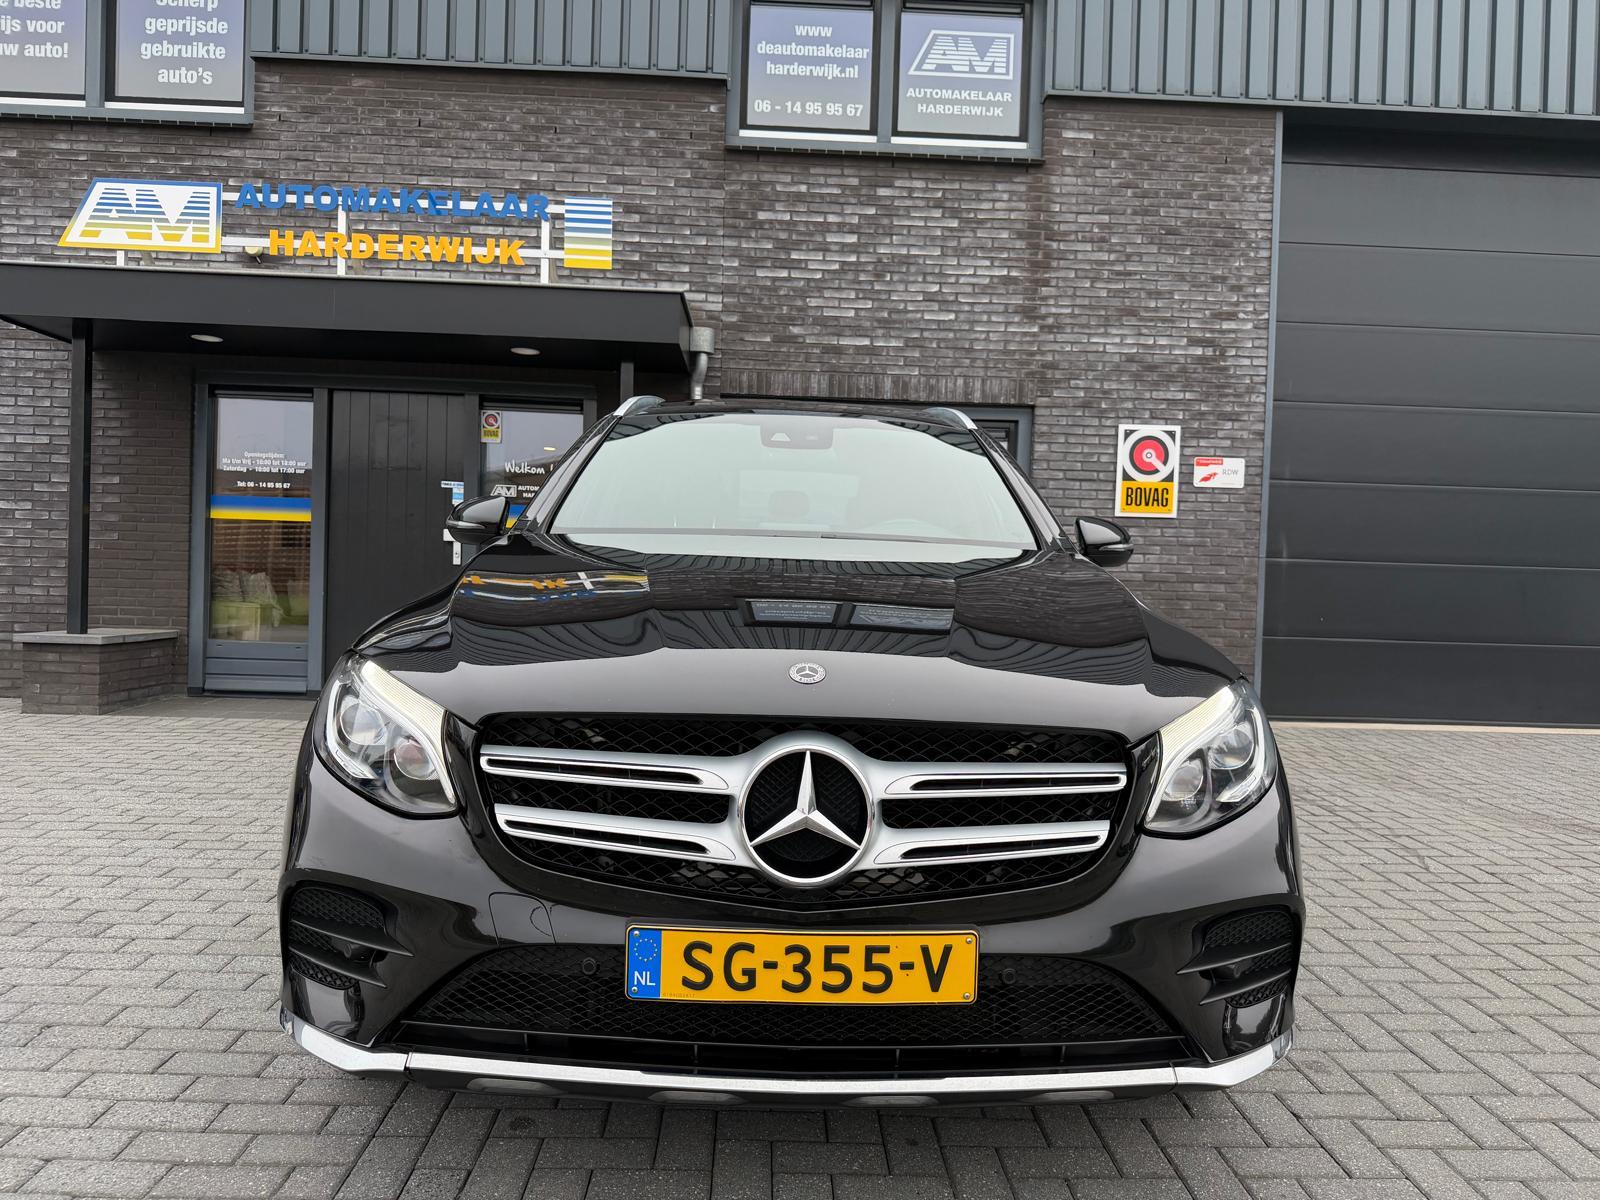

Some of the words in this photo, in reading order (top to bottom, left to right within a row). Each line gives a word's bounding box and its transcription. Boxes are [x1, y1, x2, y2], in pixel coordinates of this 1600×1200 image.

[26, 19, 65, 34] voor
[145, 16, 228, 36] geprijsde
[795, 25, 832, 37] www
[24, 42, 69, 58] auto!
[141, 41, 226, 60] gebruikte
[756, 41, 870, 59] deautomakelaar
[157, 67, 213, 84] auto's
[766, 61, 859, 80] harderwijk.nl
[906, 87, 1013, 102] AUTOMAKELAAR
[754, 99, 771, 113] 06
[785, 101, 802, 114] 14
[805, 102, 822, 115] 95
[826, 103, 843, 116] 95
[846, 104, 864, 117] 67
[917, 103, 1004, 117] HARDERWIJK
[79, 187, 210, 242] AM
[235, 183, 550, 221] AUTOMAKELAAR
[269, 229, 526, 265] HARDERWIJK
[504, 460, 545, 475] Welkom
[1222, 468, 1239, 476] RDW
[1125, 487, 1169, 507] BOVAG
[681, 940, 953, 994] SG-355-V
[633, 971, 656, 986] NL
